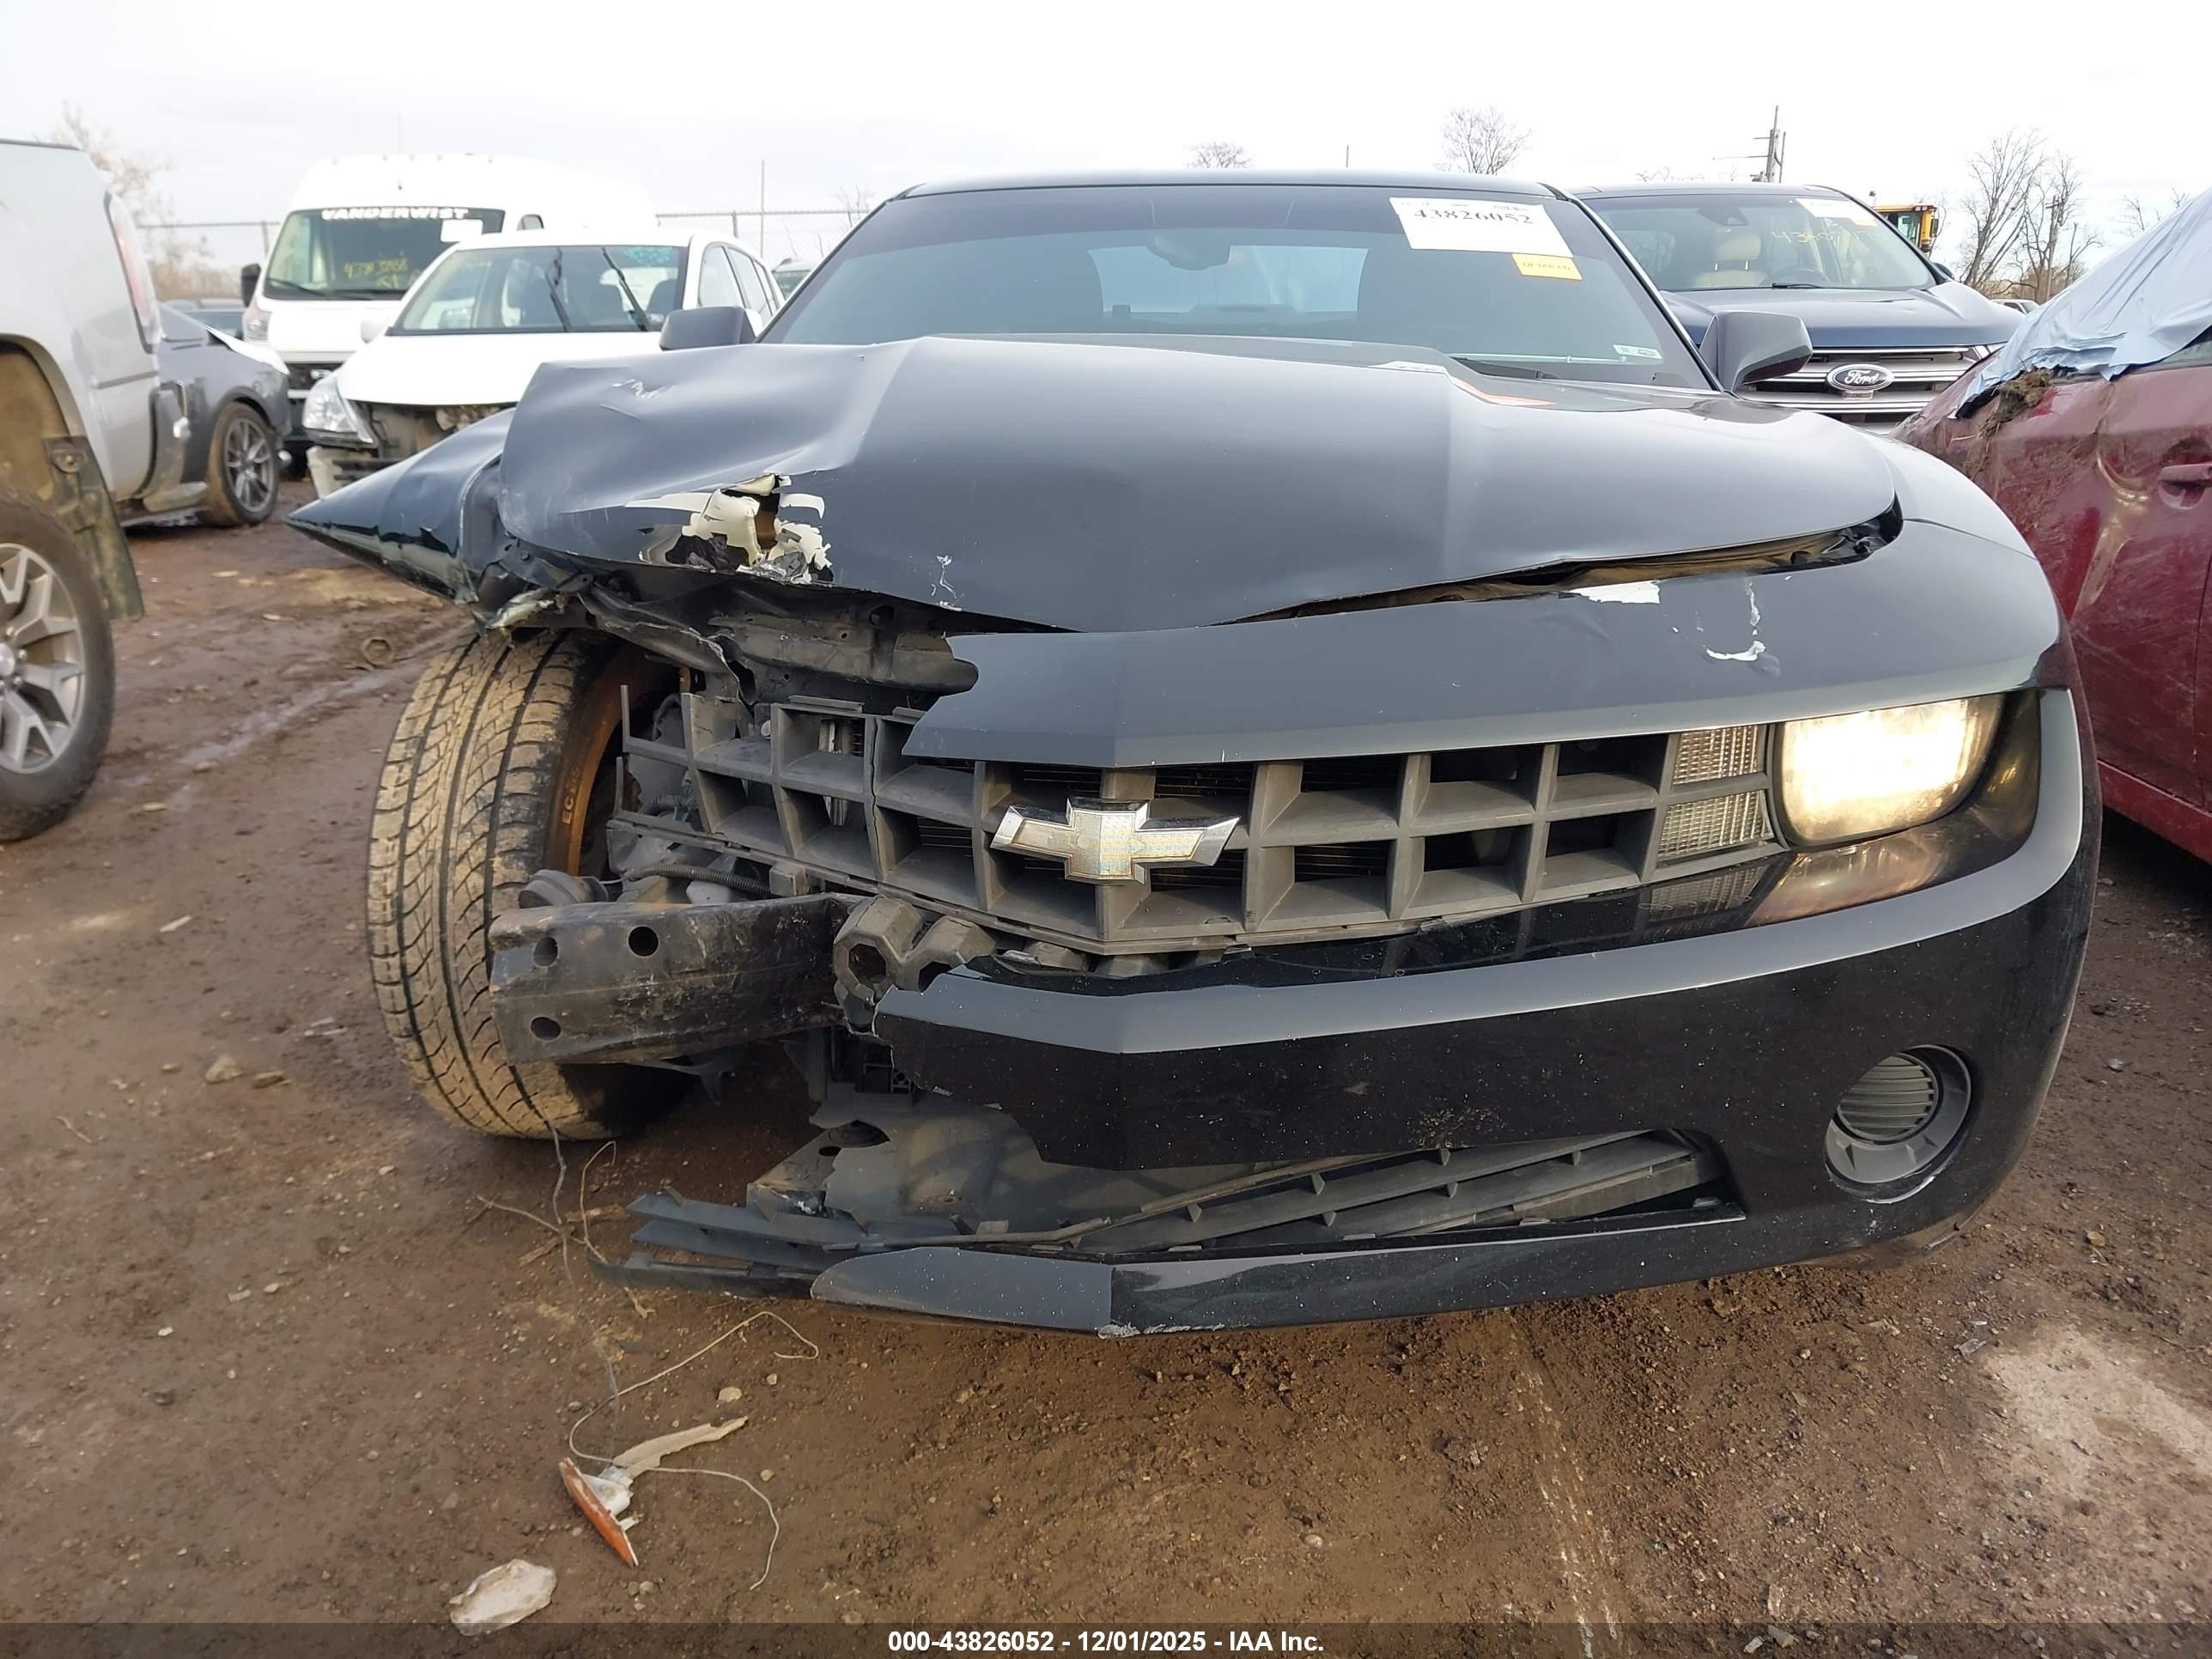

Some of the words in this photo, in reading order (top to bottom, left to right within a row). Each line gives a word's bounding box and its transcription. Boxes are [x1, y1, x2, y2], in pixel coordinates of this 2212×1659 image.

[321, 206, 469, 221] VANDERWIST
[1414, 209, 1533, 224] 43826052
[1844, 369, 1880, 385] Ford
